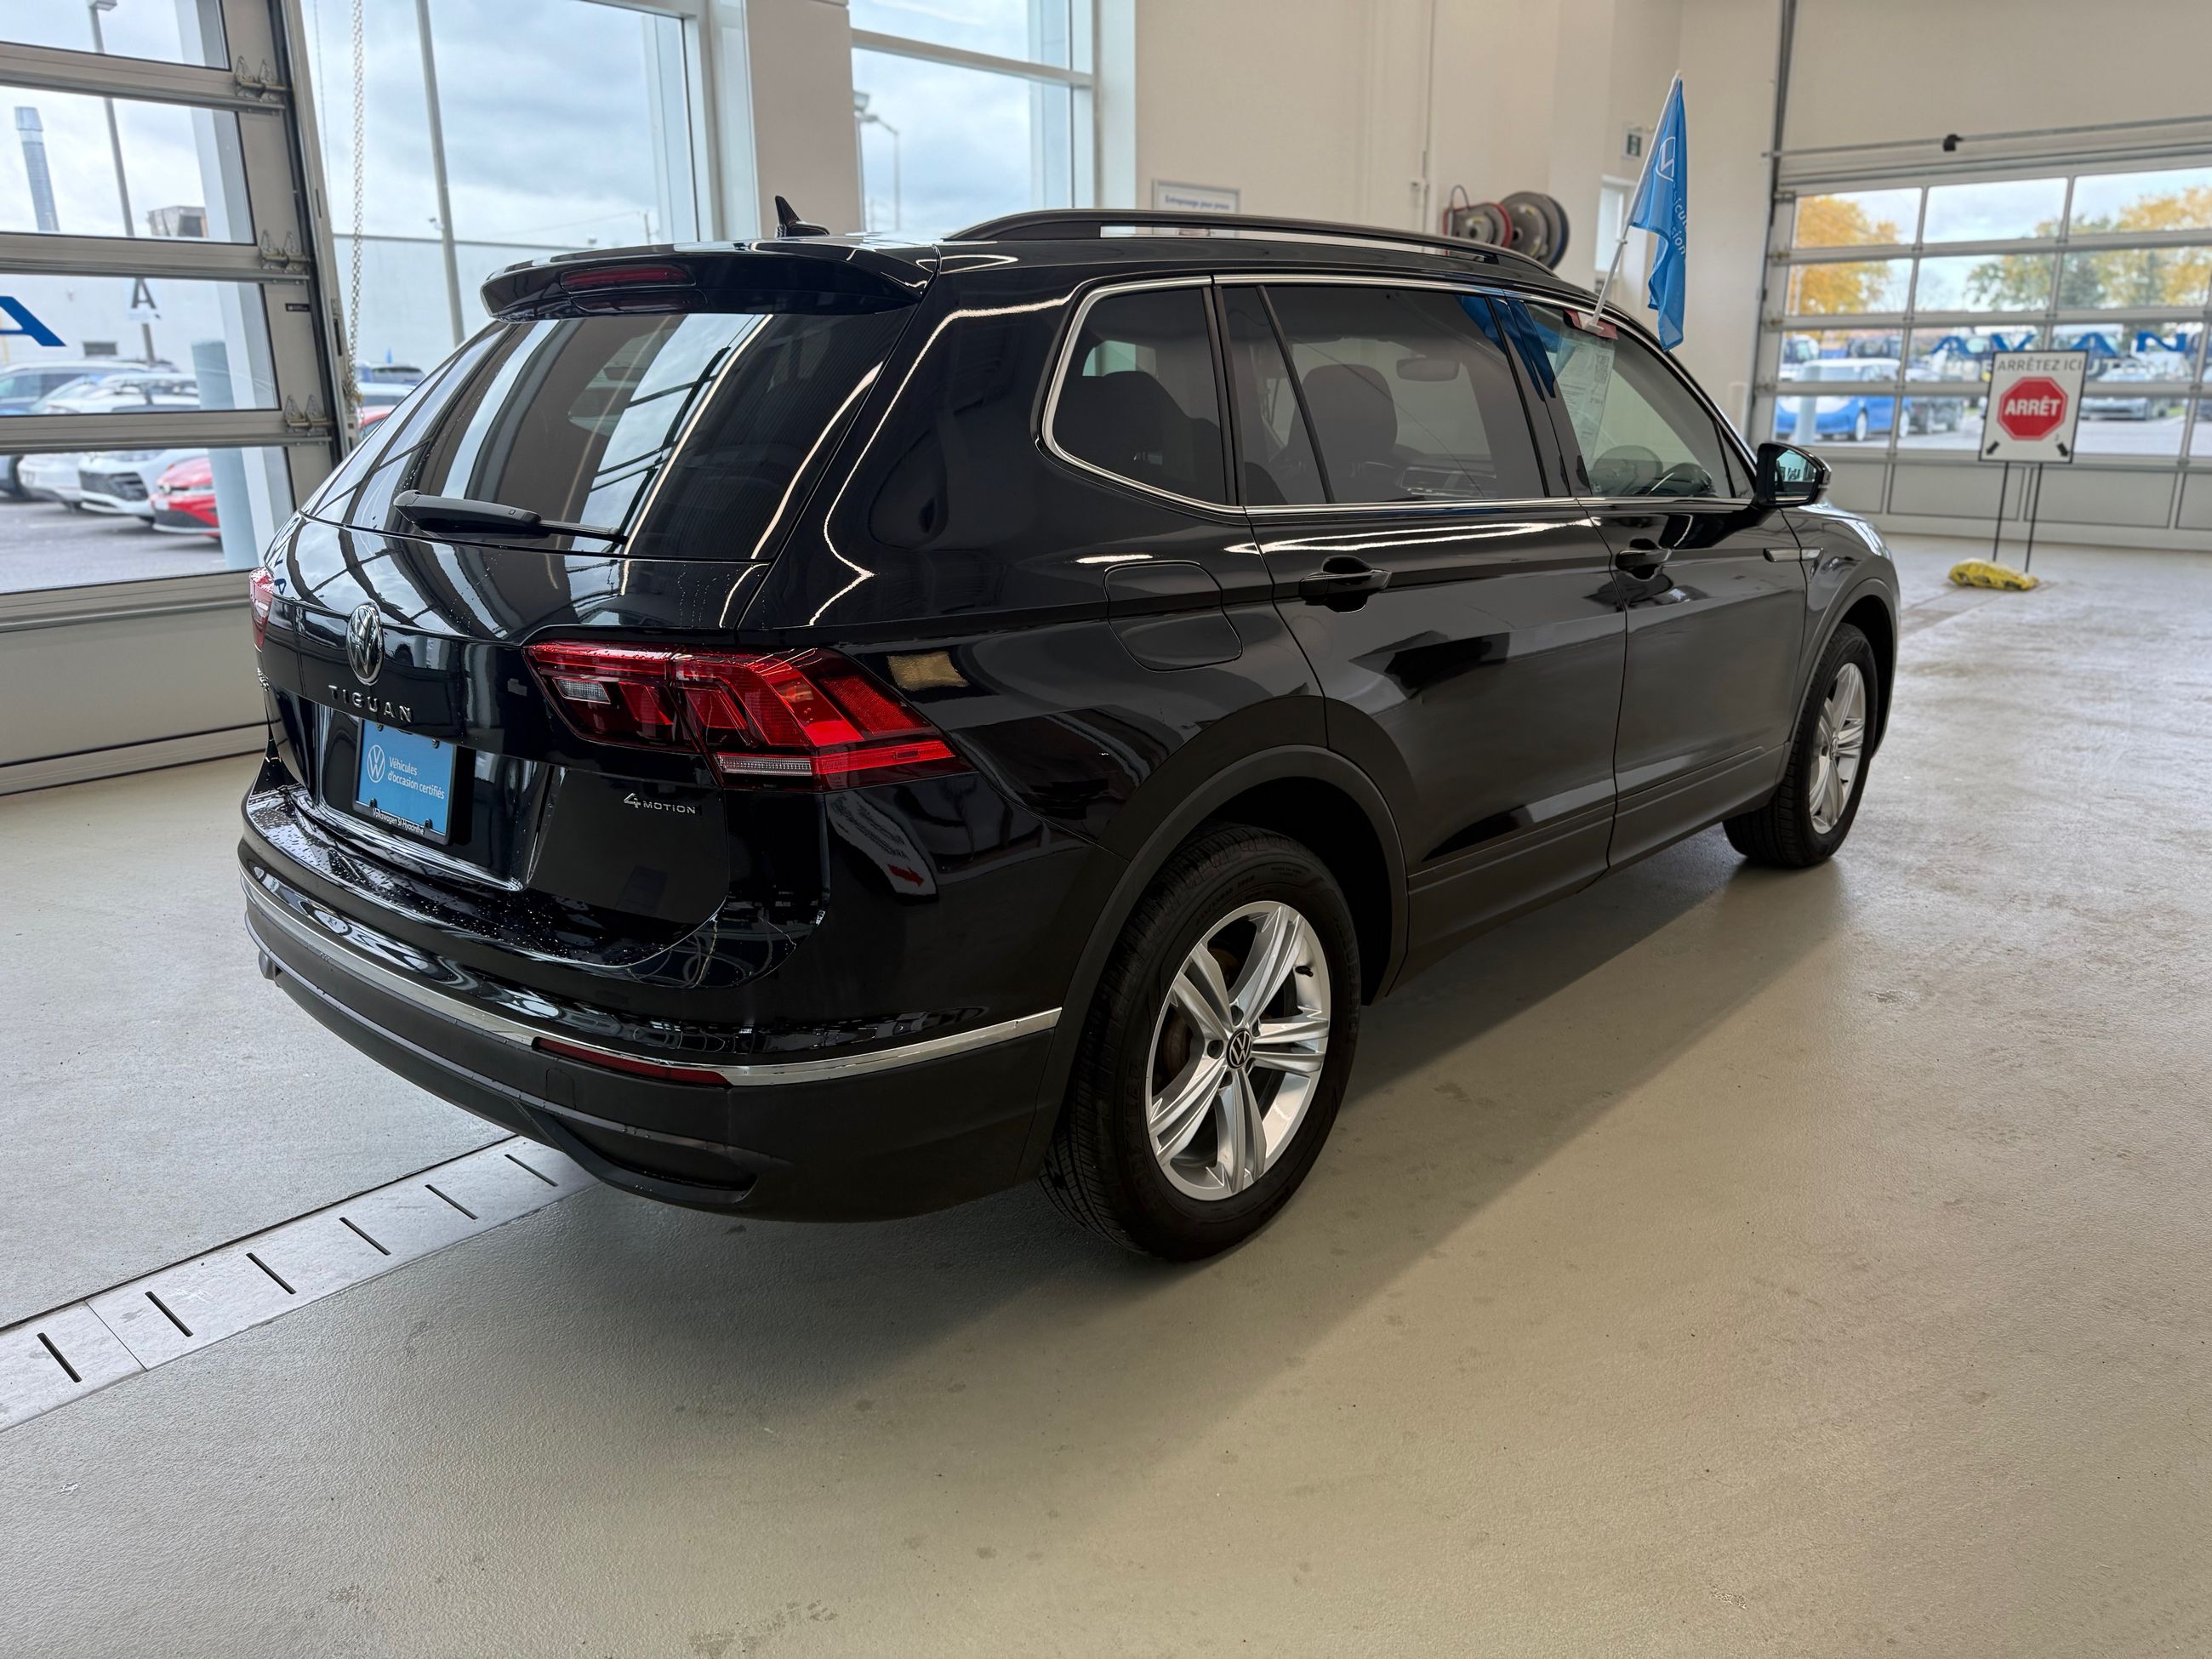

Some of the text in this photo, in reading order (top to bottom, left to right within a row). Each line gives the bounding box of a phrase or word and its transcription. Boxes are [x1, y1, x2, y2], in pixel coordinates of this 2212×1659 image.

[1997, 357, 2060, 372] ARRÊTEZ
[2063, 358, 2083, 372] ICI
[2004, 395, 2061, 417] ARRÊT
[328, 685, 413, 723] TIGUAN
[389, 756, 418, 776] Véhicules
[388, 771, 445, 800] d'occasion certifiés
[624, 793, 696, 814] 4MOTION
